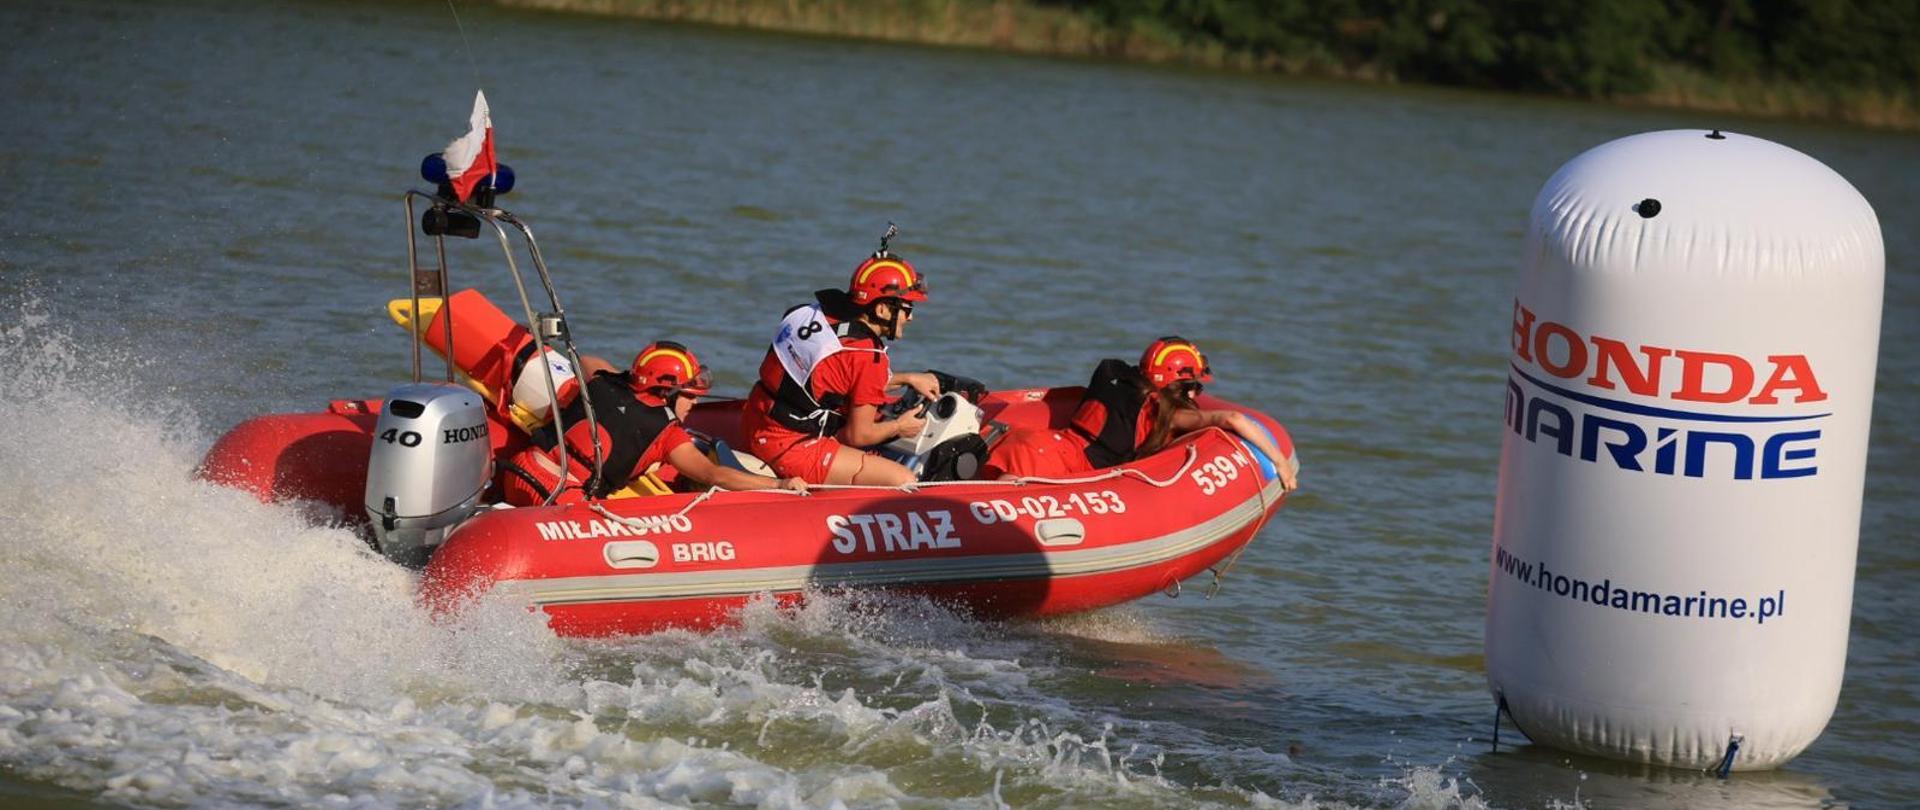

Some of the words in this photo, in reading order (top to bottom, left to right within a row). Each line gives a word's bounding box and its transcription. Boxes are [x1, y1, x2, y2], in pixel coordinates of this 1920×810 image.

[1512, 297, 1828, 404] HONDA
[380, 428, 422, 448] 40
[443, 423, 488, 444] HOND
[1505, 375, 1822, 480] MARINE
[1191, 456, 1238, 496] 539
[970, 490, 1126, 524] GD-02-153
[672, 542, 735, 562] BRIG
[1496, 543, 1784, 624] www.hondamarine.pl
